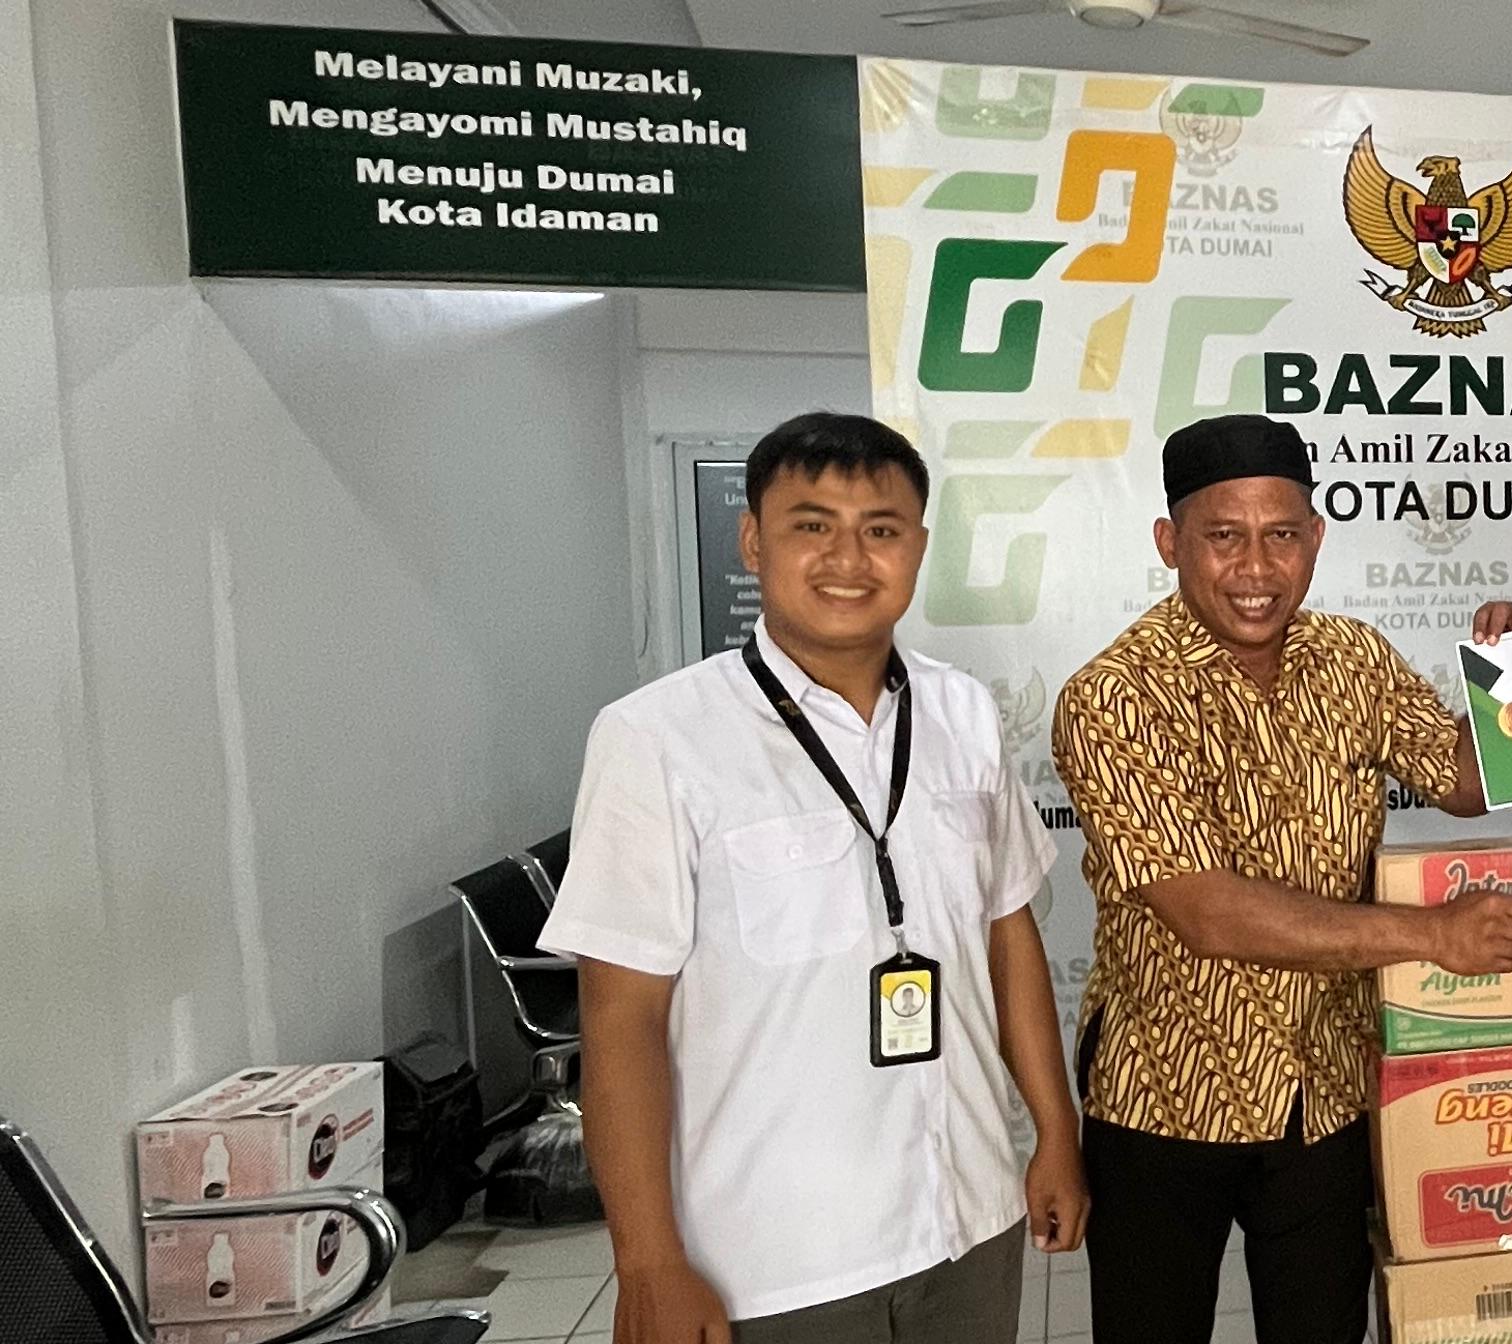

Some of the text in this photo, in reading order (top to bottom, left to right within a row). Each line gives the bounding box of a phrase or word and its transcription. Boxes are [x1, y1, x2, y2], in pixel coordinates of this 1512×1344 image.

[314, 51, 702, 102] Melayani Muzaki,
[268, 100, 747, 151] Mengayomi Mustahiq
[355, 158, 675, 196] Menuju Dumai
[1123, 180, 1279, 213] ZNAS
[377, 198, 659, 234] Kota Idaman
[1166, 235, 1273, 257] TA DUMAI
[1331, 434, 1415, 464] Amil
[1366, 560, 1510, 588] BAZNAS
[1375, 612, 1431, 630] KOTA
